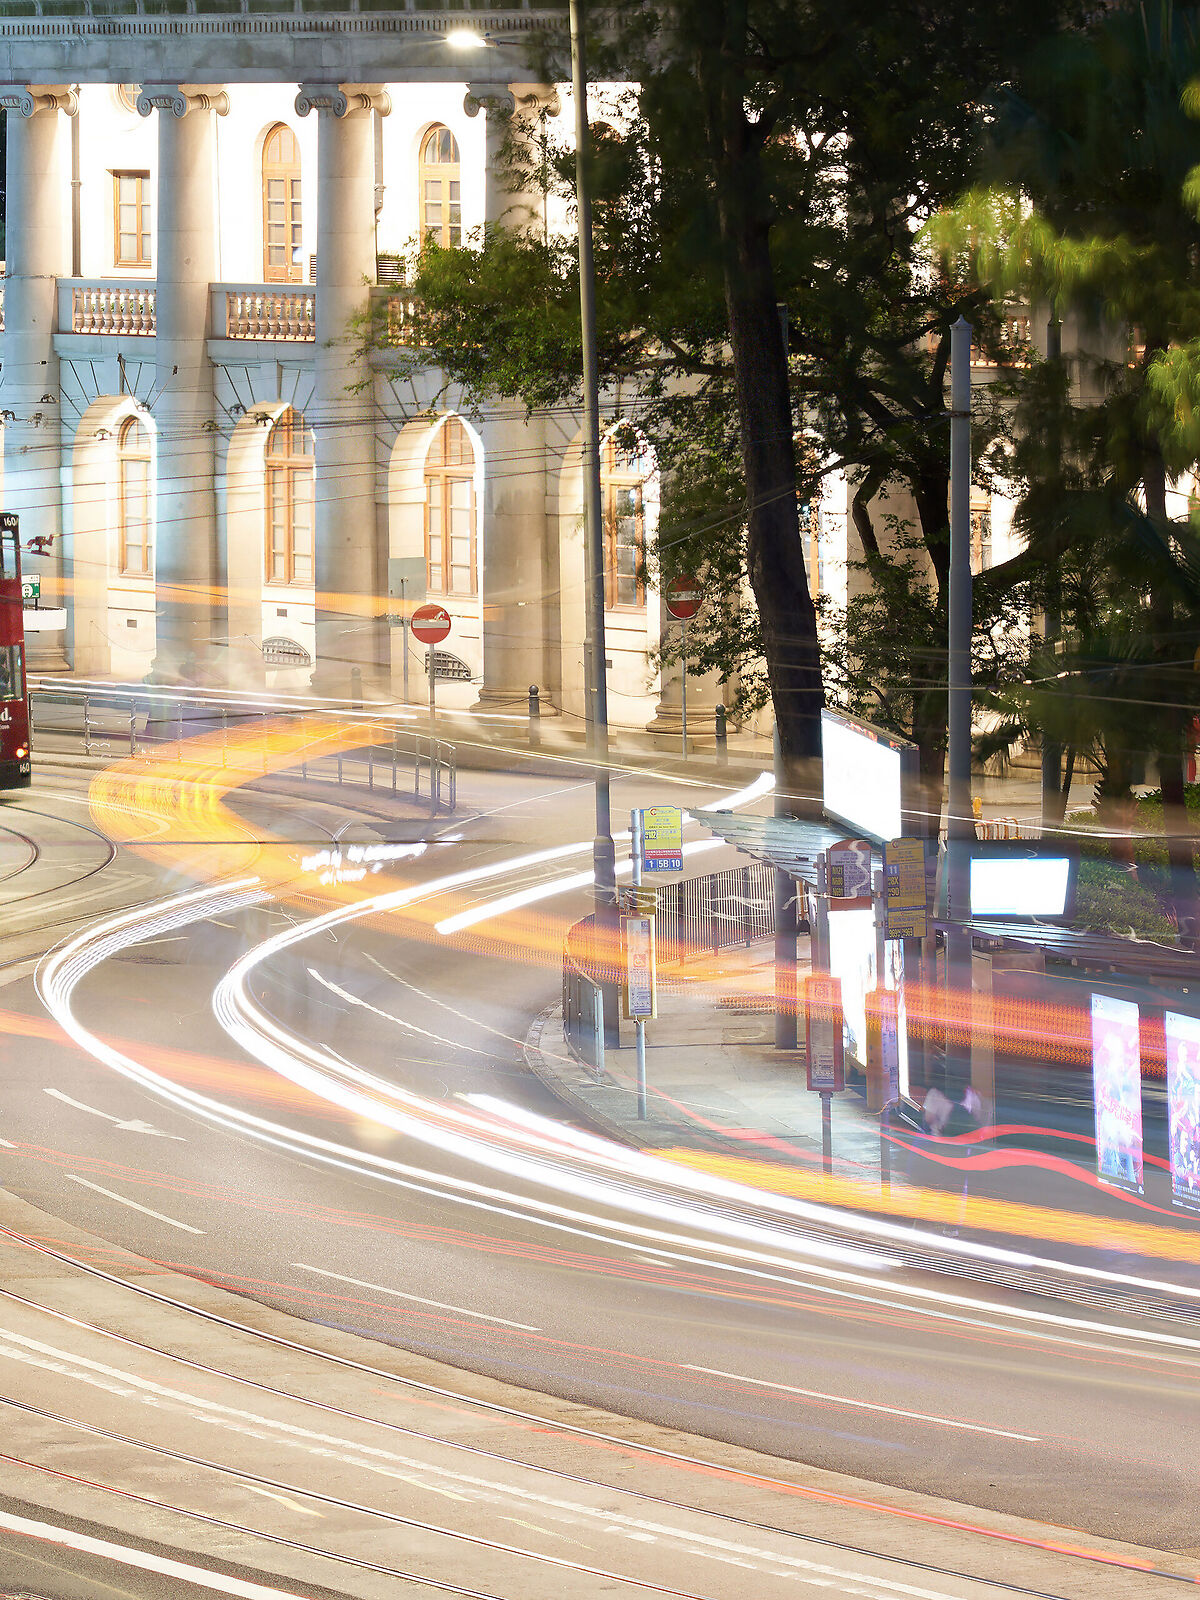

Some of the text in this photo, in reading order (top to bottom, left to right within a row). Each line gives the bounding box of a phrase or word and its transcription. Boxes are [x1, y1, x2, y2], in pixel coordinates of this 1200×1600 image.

[3, 517, 17, 527] 160
[658, 859, 669, 868] 5B
[671, 859, 681, 868] 10
[889, 866, 898, 874] 11
